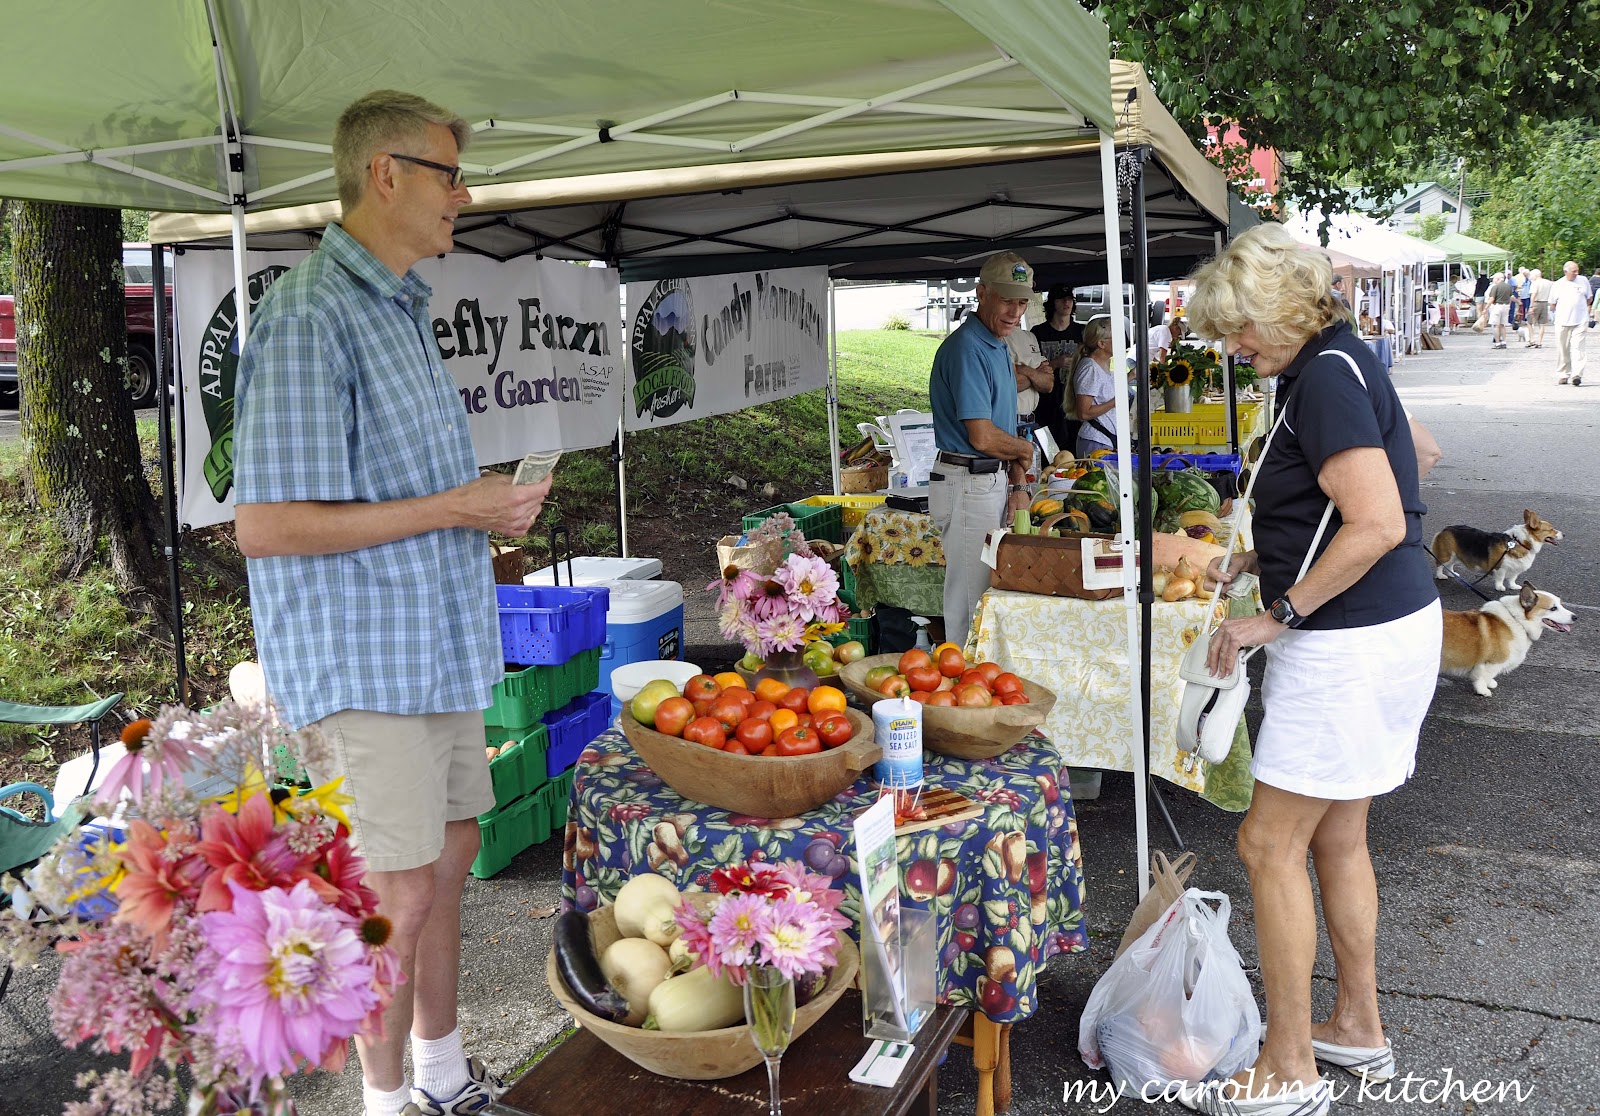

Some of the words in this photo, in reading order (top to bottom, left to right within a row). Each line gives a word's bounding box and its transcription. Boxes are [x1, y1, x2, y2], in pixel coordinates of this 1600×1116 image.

[201, 270, 284, 399] APPALCHI
[518, 298, 611, 357] Farm
[494, 366, 582, 409] Garden
[579, 362, 614, 378] ASAP
[636, 369, 669, 400] LOCAL
[744, 354, 787, 398] Farm
[889, 731, 917, 741] IODIZED
[889, 742, 902, 750] SEA
[904, 740, 917, 750] SALT
